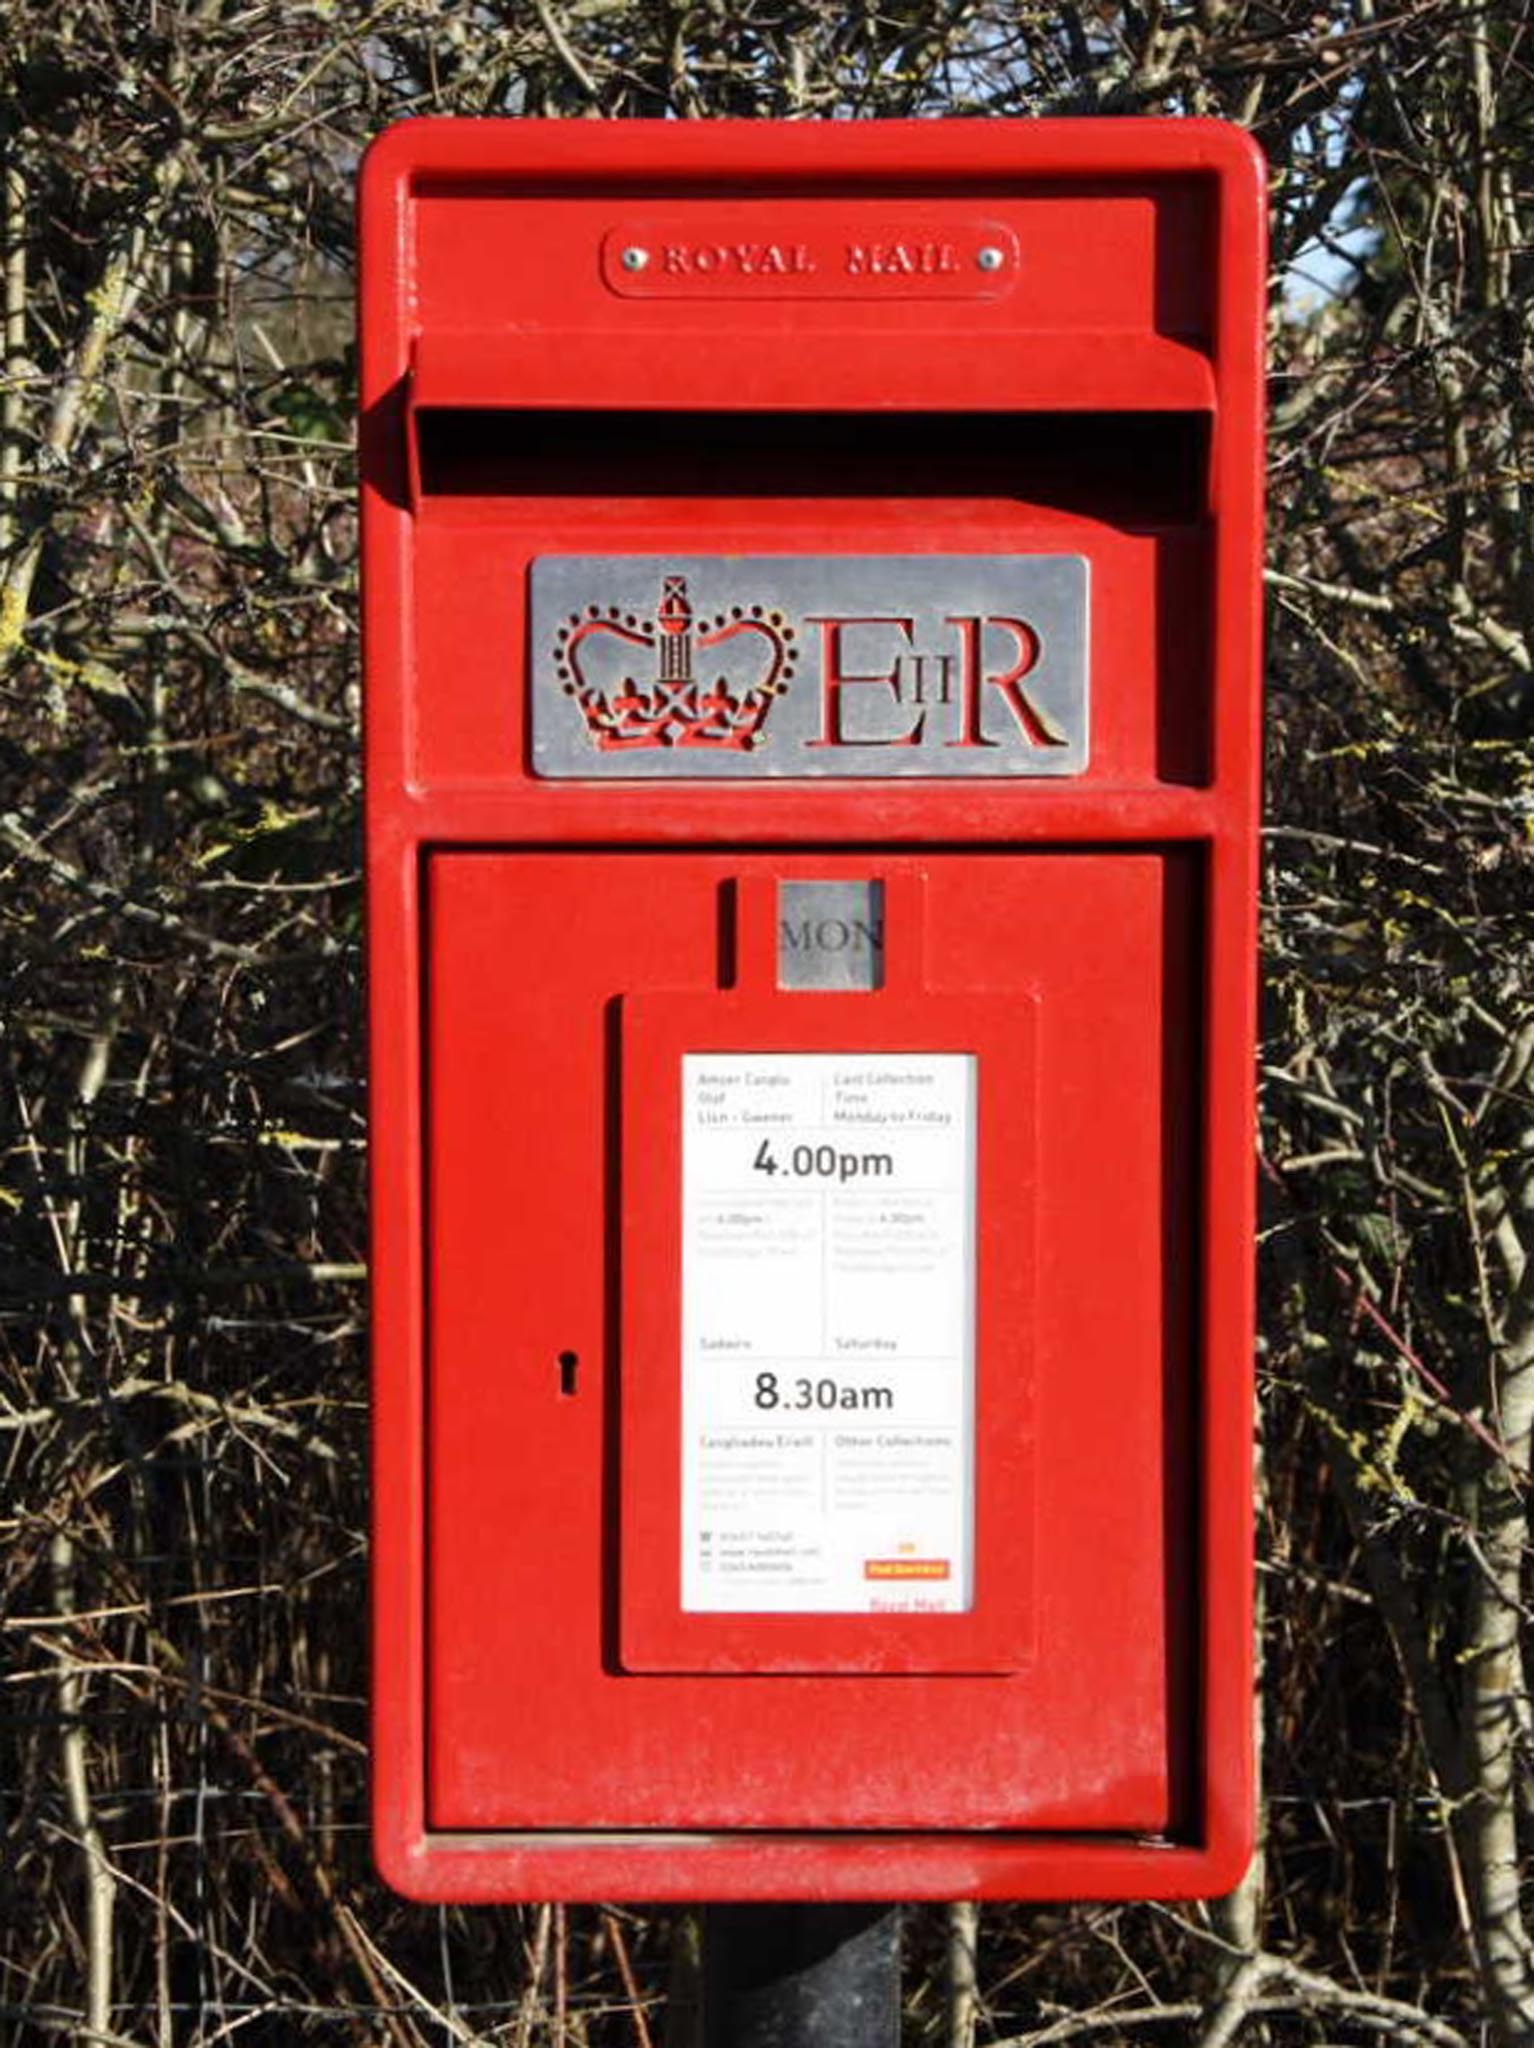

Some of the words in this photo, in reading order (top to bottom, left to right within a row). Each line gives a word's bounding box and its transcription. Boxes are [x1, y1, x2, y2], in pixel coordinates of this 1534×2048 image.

[662, 243, 817, 274] ROYAL
[846, 243, 962, 274] MAIL
[779, 918, 884, 952] MON
[752, 1138, 894, 1184] 4.00pm
[754, 1371, 894, 1411] 8.30am
